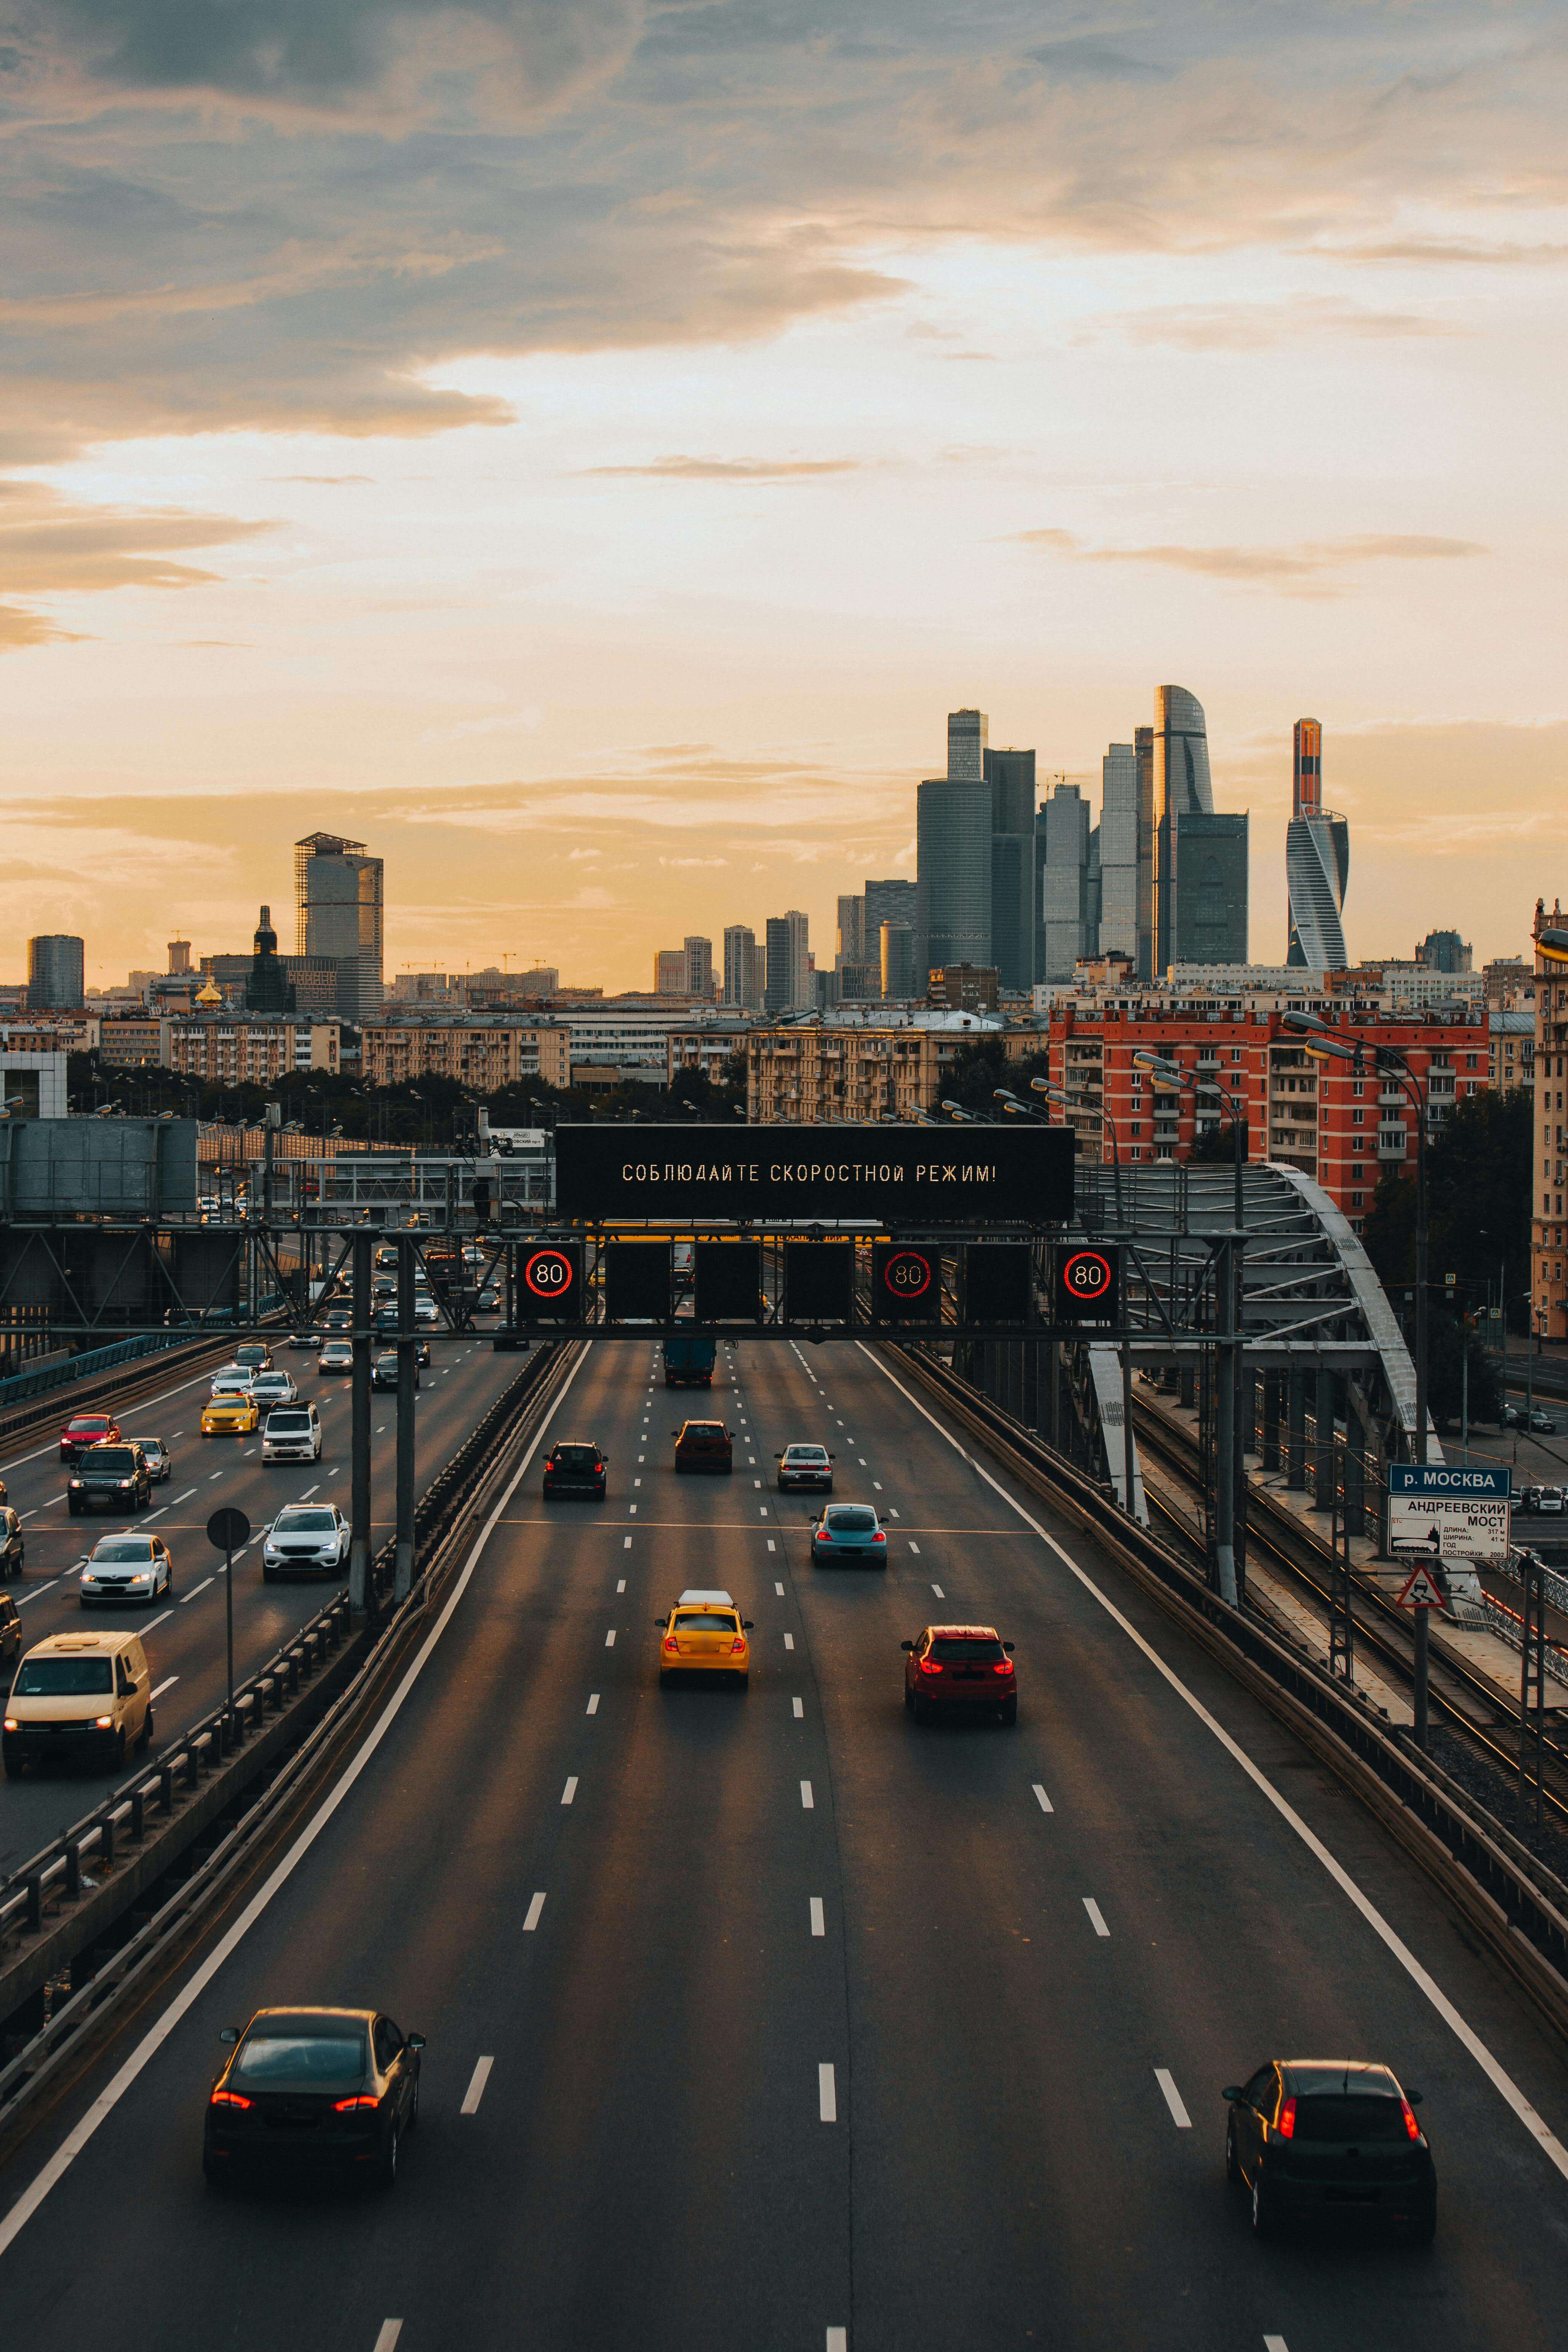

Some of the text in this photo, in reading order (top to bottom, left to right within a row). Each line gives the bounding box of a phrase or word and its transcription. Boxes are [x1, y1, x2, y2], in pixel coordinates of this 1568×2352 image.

[622, 1164, 996, 1182] СОБЛЮДАЙТЕ СКОРОСТНОЙ РЕЖИМ!
[537, 1264, 562, 1283] 80
[896, 1266, 921, 1284] 80
[1075, 1266, 1101, 1285] 80
[1405, 1472, 1495, 1487] р. МОСКВА
[1408, 1501, 1506, 1515] АНДРЕЕВСКИЙ
[1468, 1516, 1506, 1527] МОСТ
